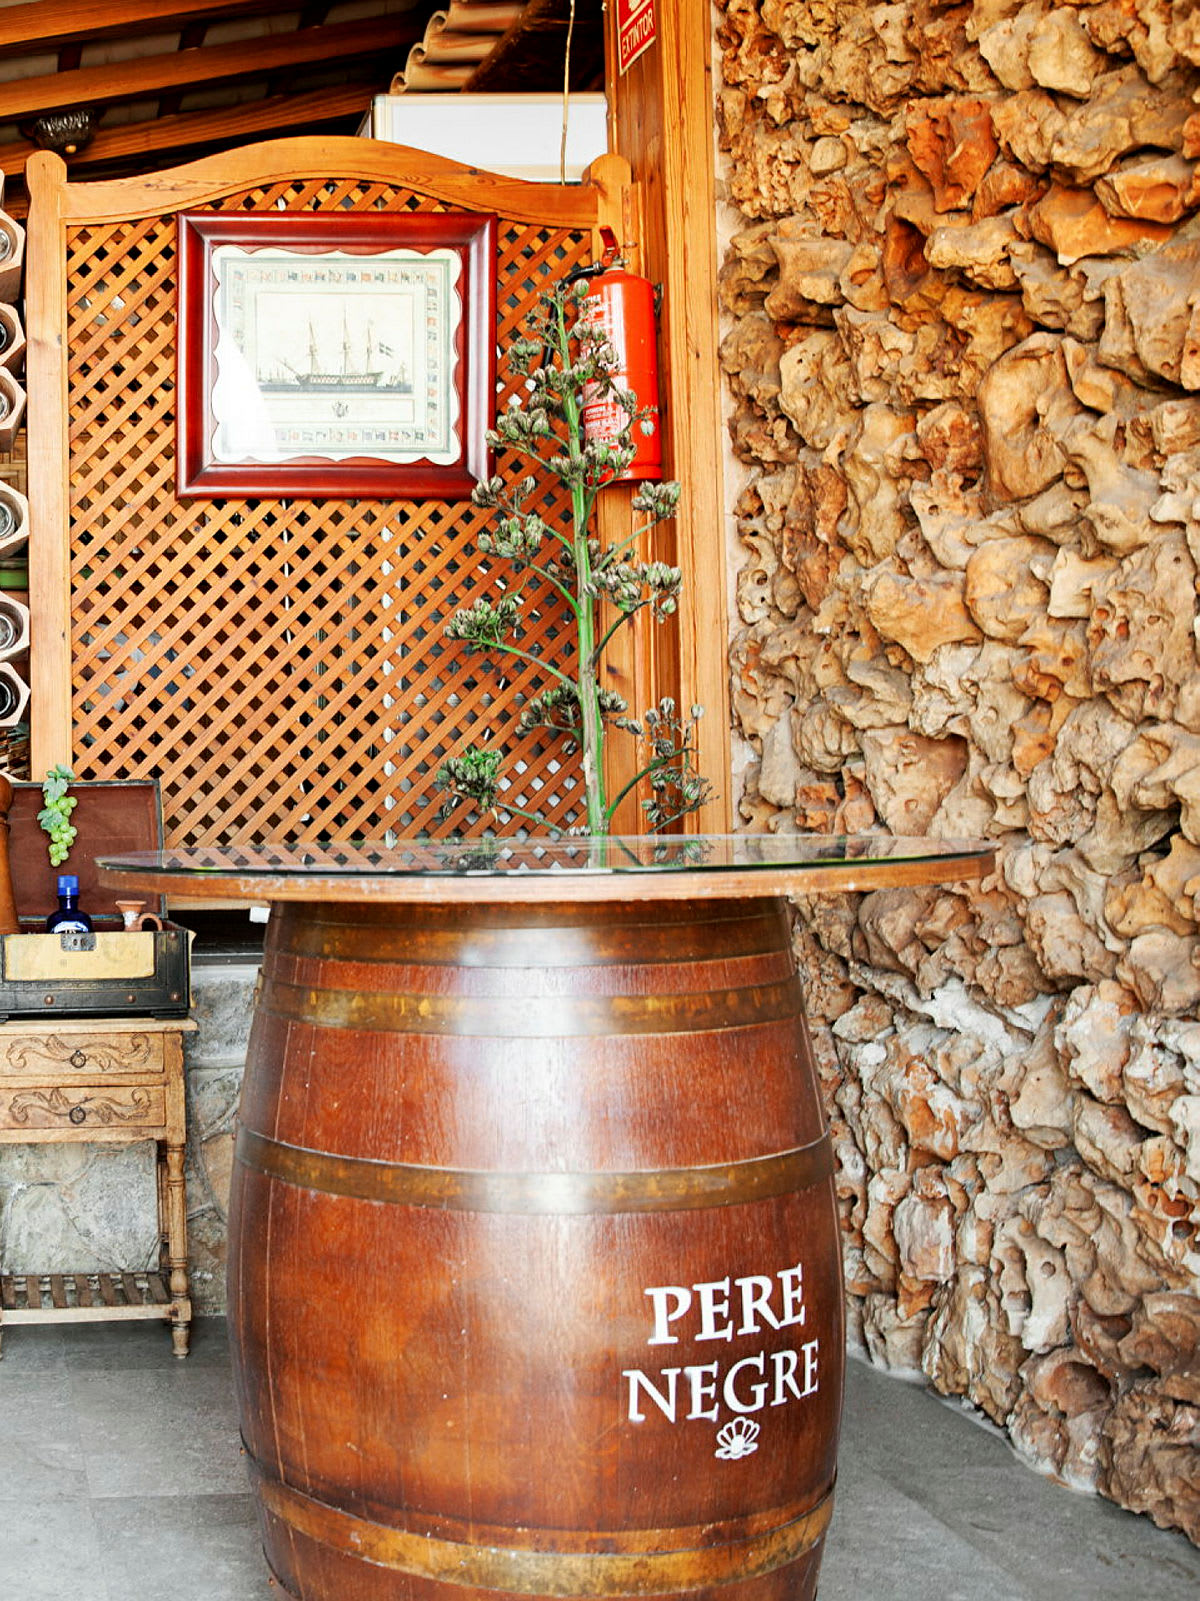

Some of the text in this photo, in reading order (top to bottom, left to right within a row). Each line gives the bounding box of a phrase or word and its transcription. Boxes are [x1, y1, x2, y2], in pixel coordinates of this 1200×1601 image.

[621, 8, 654, 60] EXTINTOR
[643, 1262, 806, 1345] PERE
[622, 1338, 819, 1424] NEGRE
